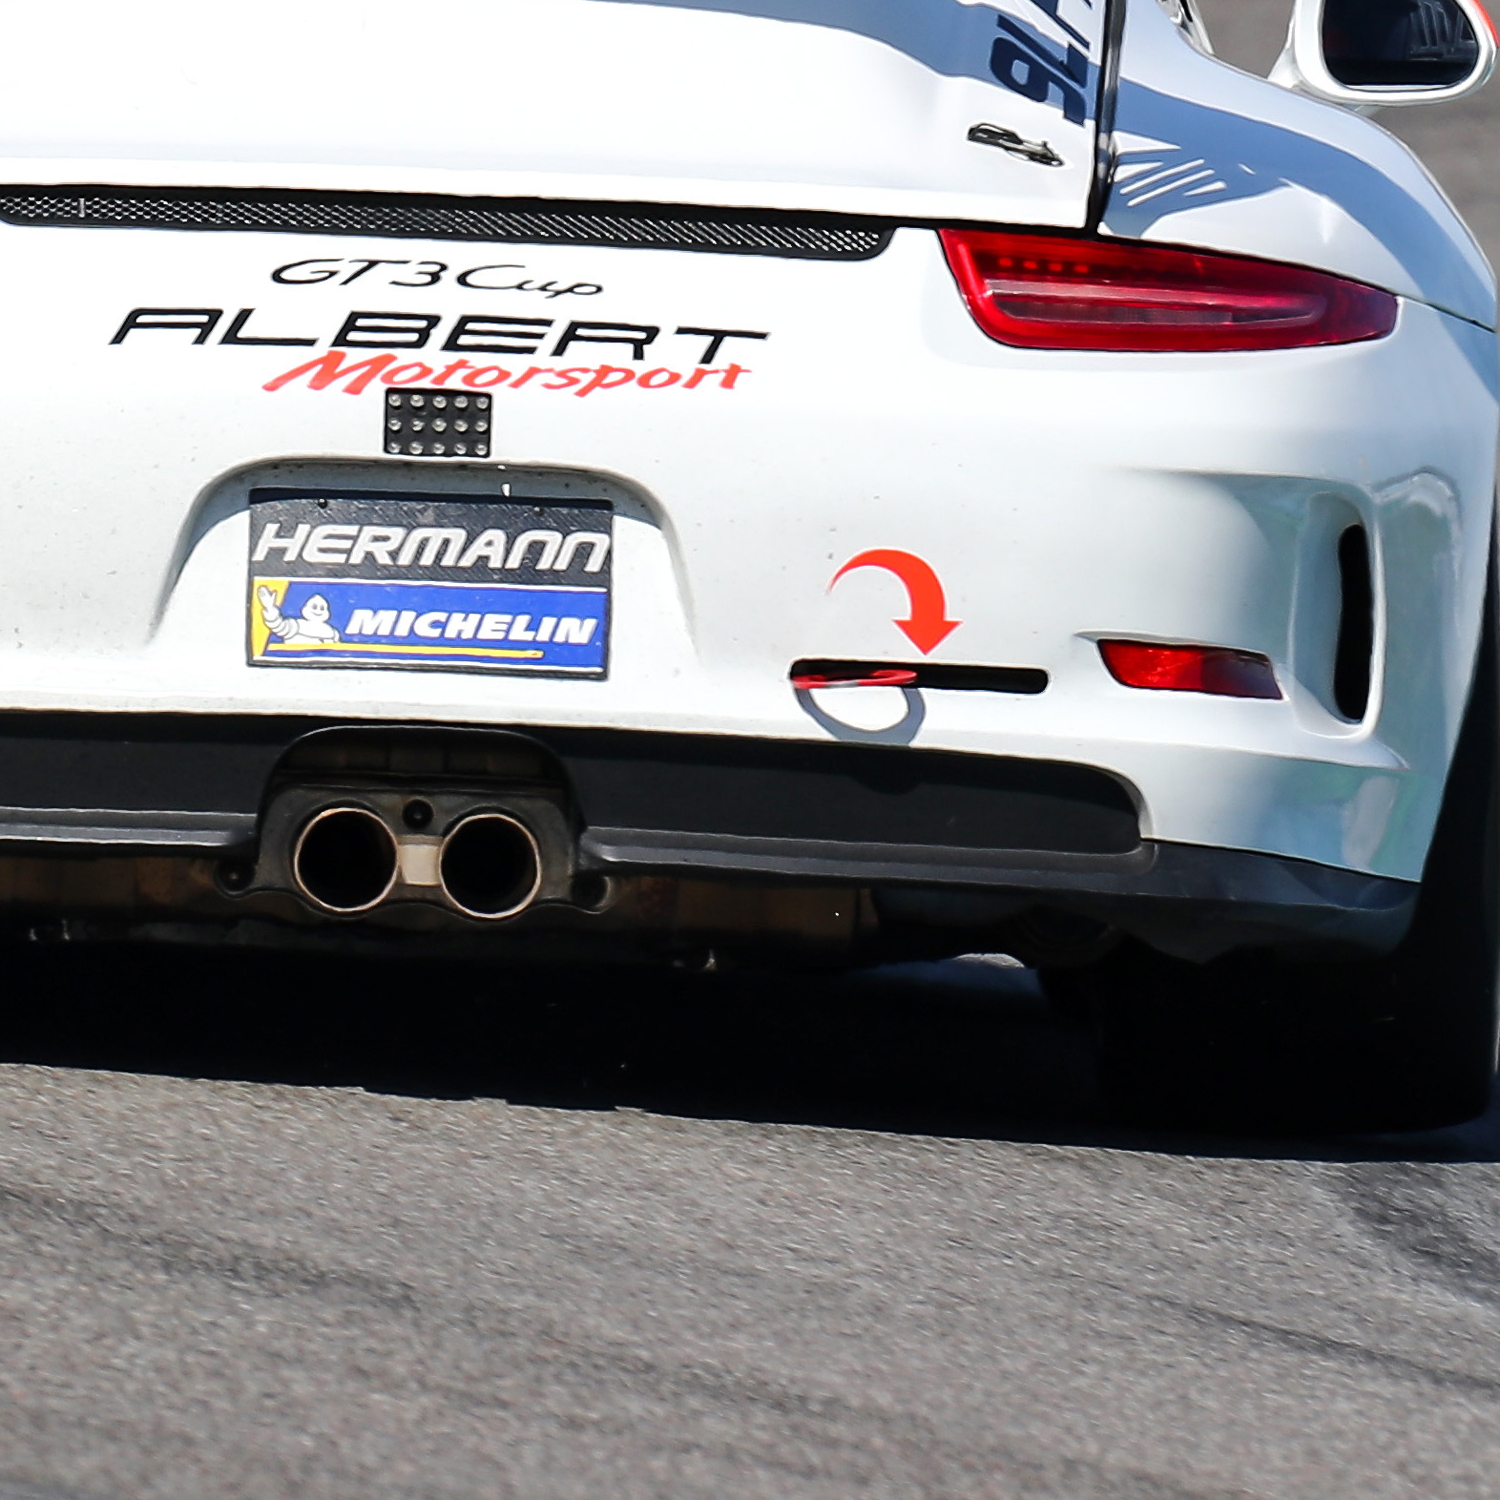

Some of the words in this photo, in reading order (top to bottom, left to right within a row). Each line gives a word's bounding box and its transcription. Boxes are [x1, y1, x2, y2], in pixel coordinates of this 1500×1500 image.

[108, 307, 771, 365] ALBERT
[262, 350, 752, 397] Motorsport
[252, 523, 610, 573] HERMANN
[344, 608, 597, 644] MICHELIN
